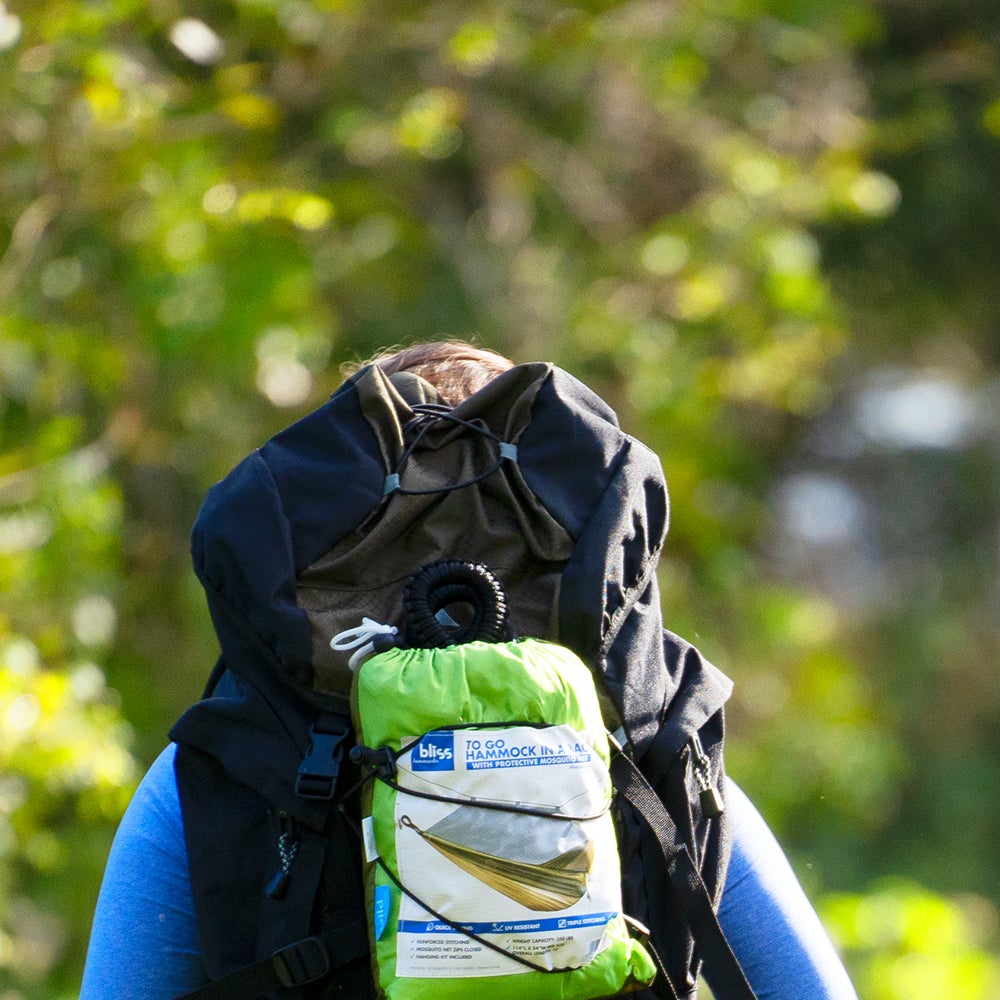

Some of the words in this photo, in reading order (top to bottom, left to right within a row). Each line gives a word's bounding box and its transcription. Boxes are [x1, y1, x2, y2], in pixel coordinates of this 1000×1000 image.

[419, 743, 453, 760] bliss
[466, 740, 481, 750] TO
[485, 739, 505, 749] GO
[466, 746, 537, 761] HAMMOCK
[541, 745, 554, 756] IN
[472, 762, 493, 770] WITH
[495, 758, 538, 768] PROTECTIVE
[540, 755, 577, 765] MOSQUITO
